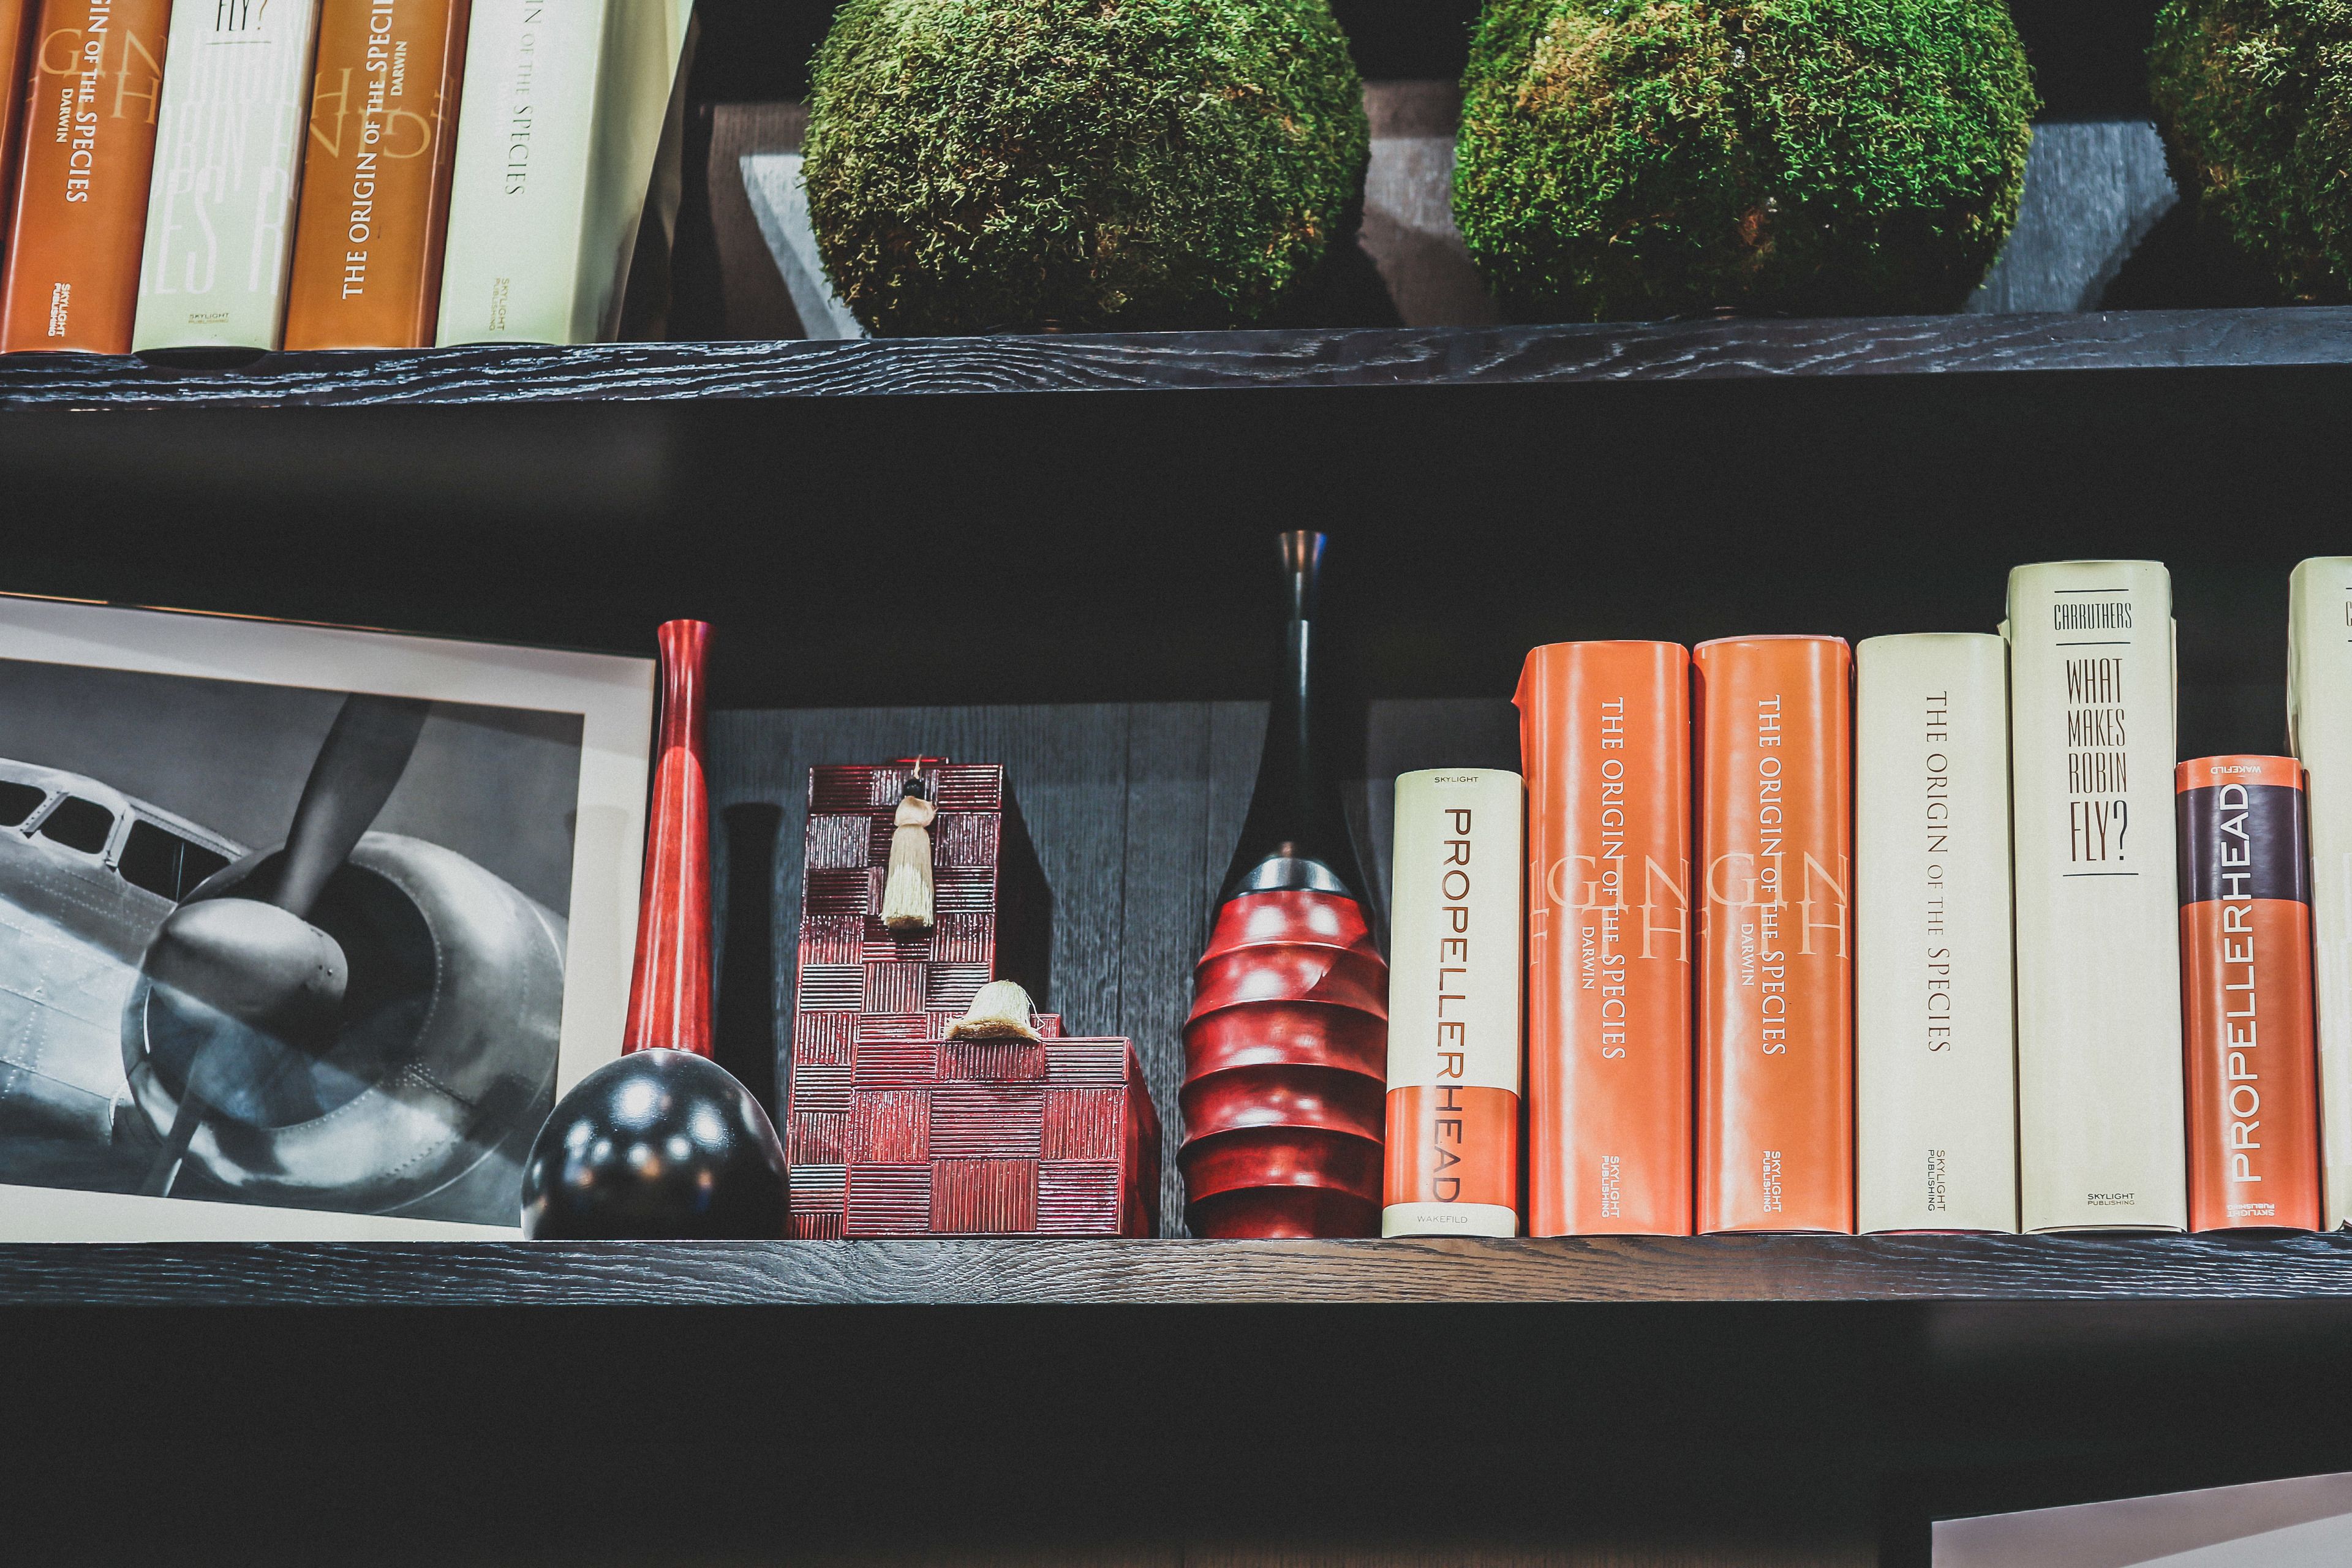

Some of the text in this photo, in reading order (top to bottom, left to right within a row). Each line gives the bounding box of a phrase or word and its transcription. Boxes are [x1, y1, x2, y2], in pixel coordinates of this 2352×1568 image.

[390, 40, 408, 96] DARWIN
[520, 34, 535, 56] OF
[66, 0, 111, 203] IN OF THE SPECIES
[366, 80, 386, 116] THE
[516, 61, 532, 95] THE
[56, 88, 74, 143] DARWIN
[363, 120, 381, 145] OF
[505, 105, 533, 195] SPECIES
[348, 153, 377, 243] ORIGIN
[342, 250, 368, 300] THE
[48, 282, 62, 337] PUBLISHING
[56, 283, 71, 337] SKYLIGHT
[497, 277, 510, 331] SKYLIGHT
[2054, 603, 2132, 630] CARRUTHERS
[2067, 658, 2123, 704] WHAT
[2067, 708, 2126, 747] MAKES
[2068, 752, 2127, 794] ROBIN
[2210, 765, 2262, 775] WAKEFILD
[2070, 800, 2128, 862] FLY?
[1601, 696, 1626, 1060] THE ORIGIN OF THE SPECIES
[1758, 693, 1786, 1055] THE ORIGIN OF THE SPECIES
[1926, 690, 1950, 1052] THE ORIGIN OF THE SPECIES
[1581, 925, 1595, 990] DARWIN
[1741, 922, 1755, 986] DARWIN
[1433, 809, 1471, 1203] PROPELLERHEAD
[2218, 783, 2262, 1183] PROPELLERHEAD
[1601, 1155, 1610, 1218] PUBLISHING
[1610, 1156, 1620, 1218] SKYLIGHT
[1763, 1150, 1771, 1213] PUBLISHING
[1771, 1151, 1782, 1213] SKYLIGHT
[1936, 1150, 1945, 1212] SKYLIGHT
[1417, 1215, 1468, 1224] WAKEFILD
[2226, 1209, 2275, 1218] SKYLIGHT
